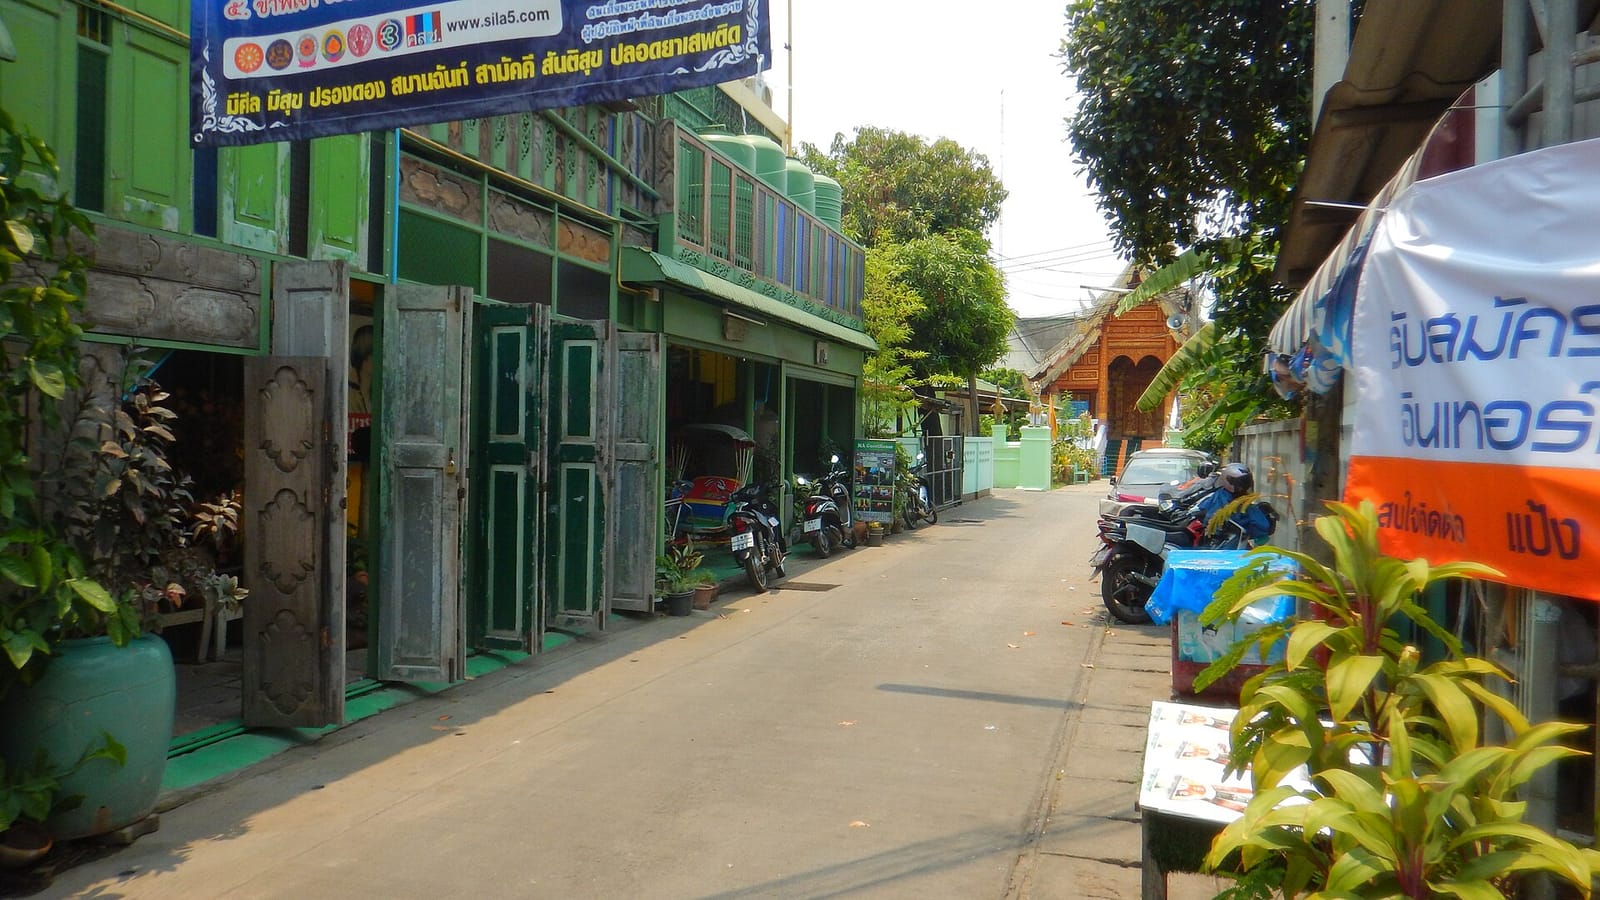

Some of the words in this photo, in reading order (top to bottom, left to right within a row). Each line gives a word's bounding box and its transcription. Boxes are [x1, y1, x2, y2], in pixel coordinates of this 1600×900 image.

[446, 9, 550, 33] www.sila5.com
[226, 92, 261, 116] มีศีล
[267, 88, 303, 117] มีสุข
[309, 80, 386, 108] ปรองดอง
[391, 61, 469, 97] สมานฉันท์
[475, 54, 535, 84] สามัคคี
[541, 48, 603, 76] สันติสุข
[610, 24, 742, 67] ปลอดยาเสพติด
